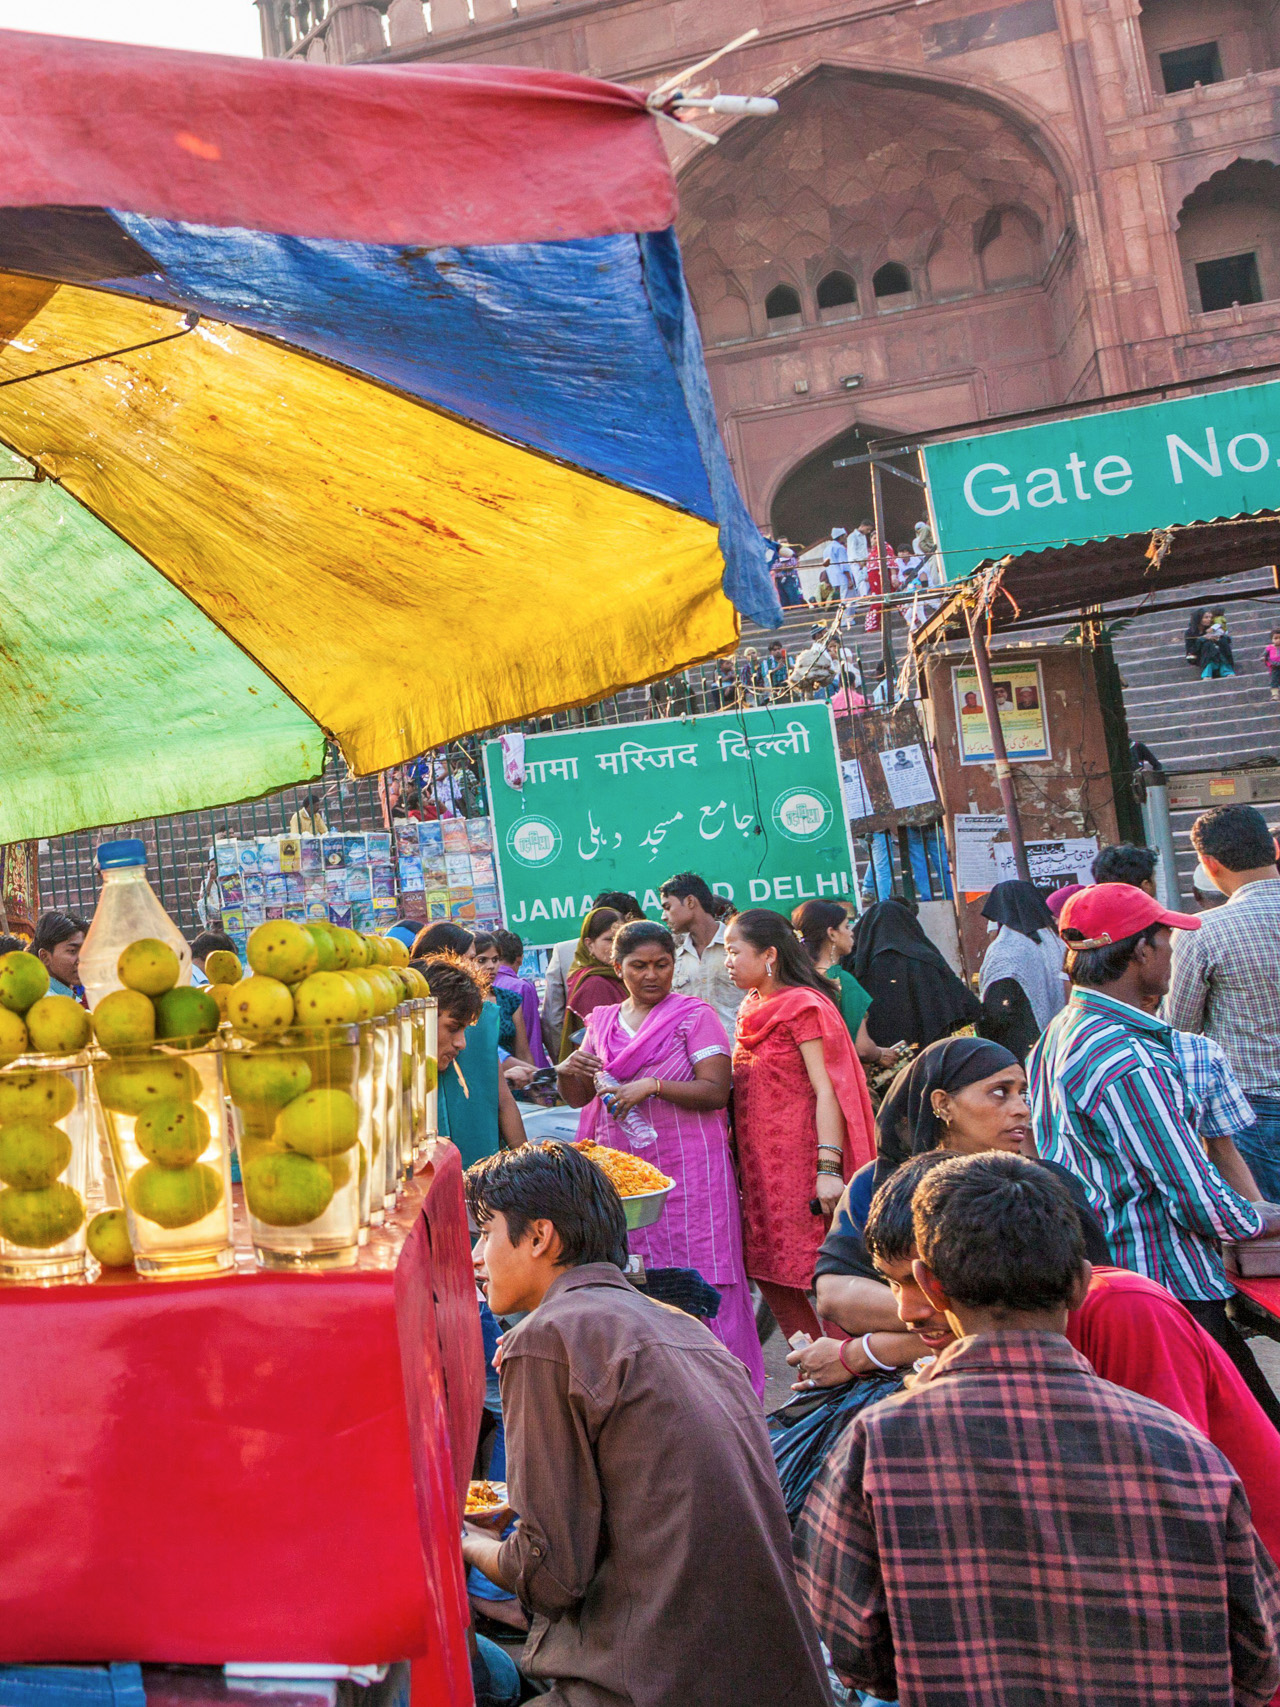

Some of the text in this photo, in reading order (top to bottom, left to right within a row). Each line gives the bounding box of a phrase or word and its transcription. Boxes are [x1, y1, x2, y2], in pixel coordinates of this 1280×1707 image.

[963, 452, 1134, 517] Gate
[595, 741, 698, 775] मस्जिद
[716, 721, 810, 761] दिल्ली
[699, 800, 754, 840] جامع
[511, 894, 594, 923] JAMA
[748, 871, 849, 902] DELHI
